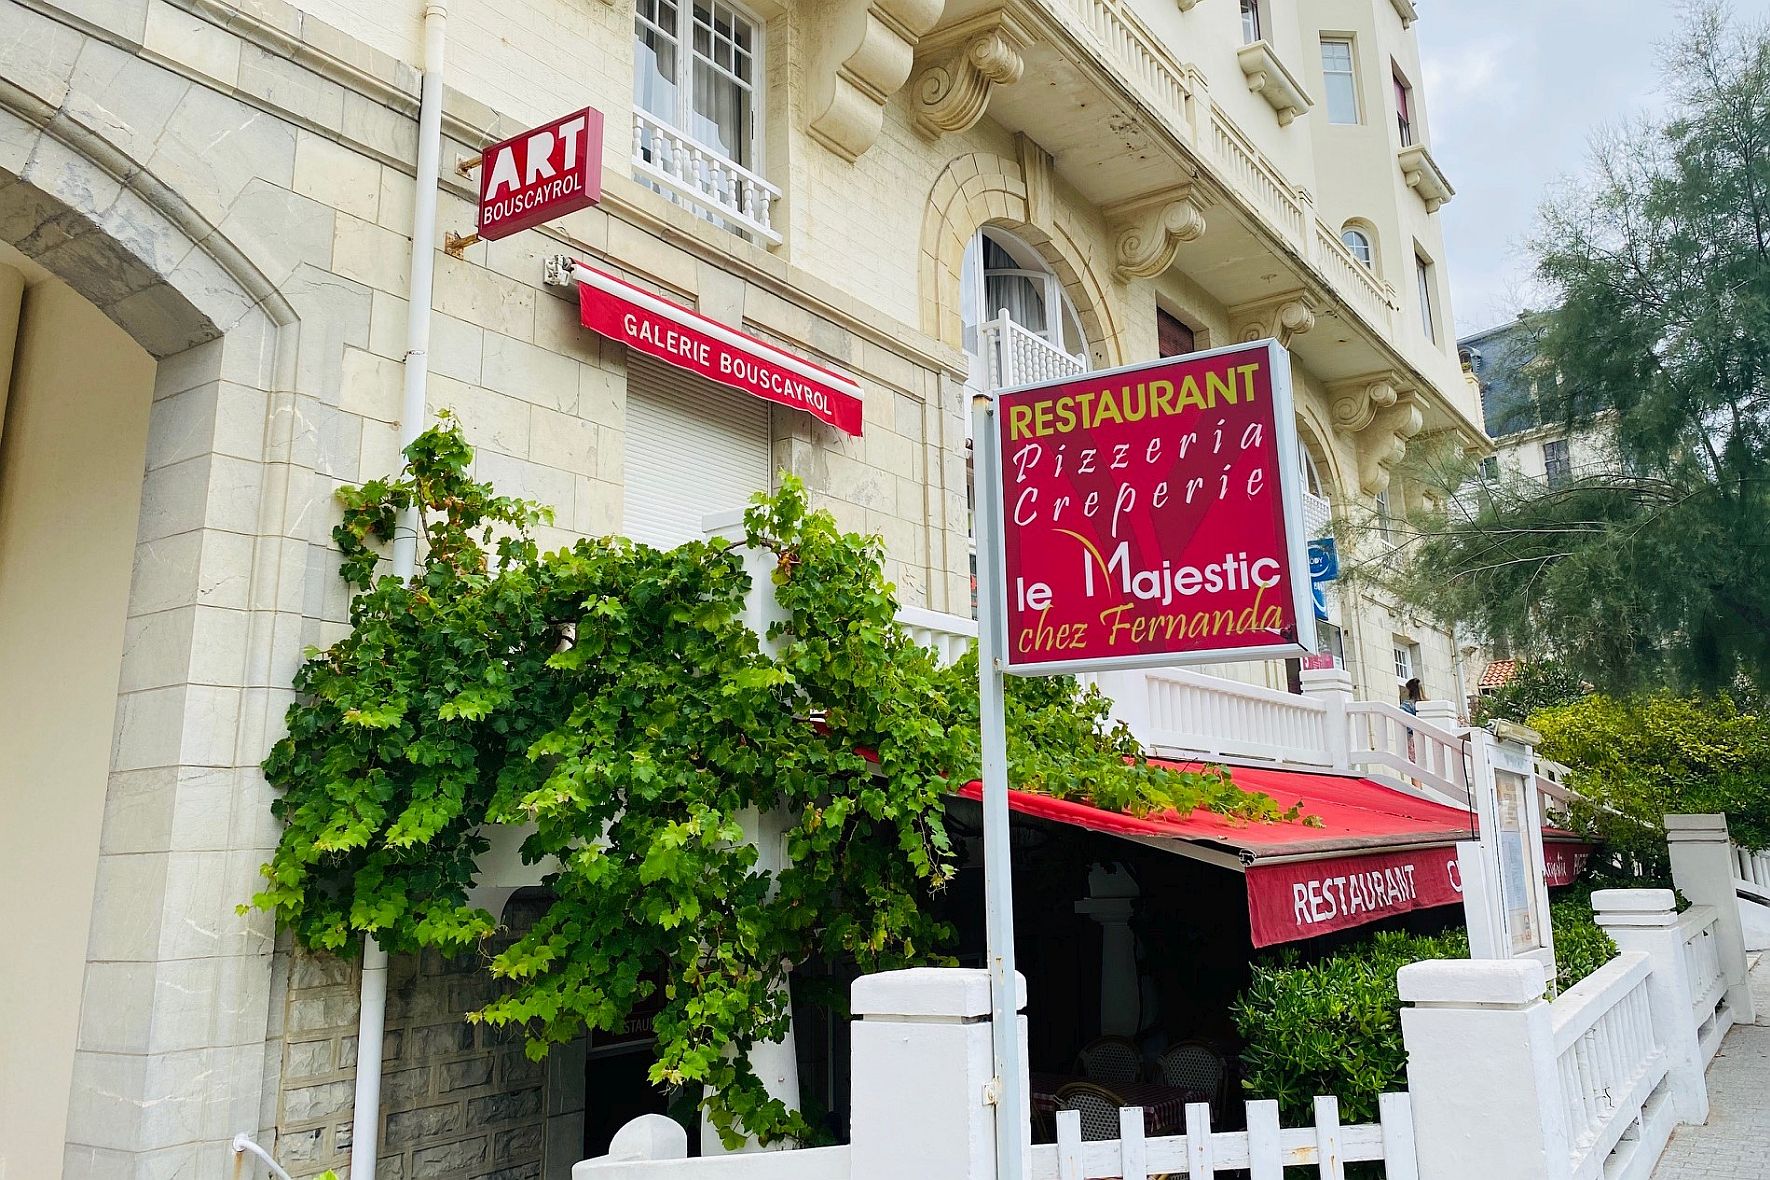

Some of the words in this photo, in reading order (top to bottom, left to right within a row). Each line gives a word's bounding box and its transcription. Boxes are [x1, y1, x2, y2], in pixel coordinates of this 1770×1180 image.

[485, 118, 585, 201] ART
[483, 172, 582, 225] BOUSCAYROL
[624, 313, 710, 367] GALERIE
[719, 351, 832, 416] BOUSCAYROL
[1010, 363, 1259, 440] RESTAURANT
[1013, 418, 1262, 483] Pizzeria
[1014, 464, 1263, 538] Creperie
[1016, 576, 1053, 612] le
[1083, 540, 1281, 606] Majestic
[1018, 603, 1088, 653] chez
[1101, 583, 1281, 645] Fernanda
[1293, 865, 1416, 925] RESTAURANT
